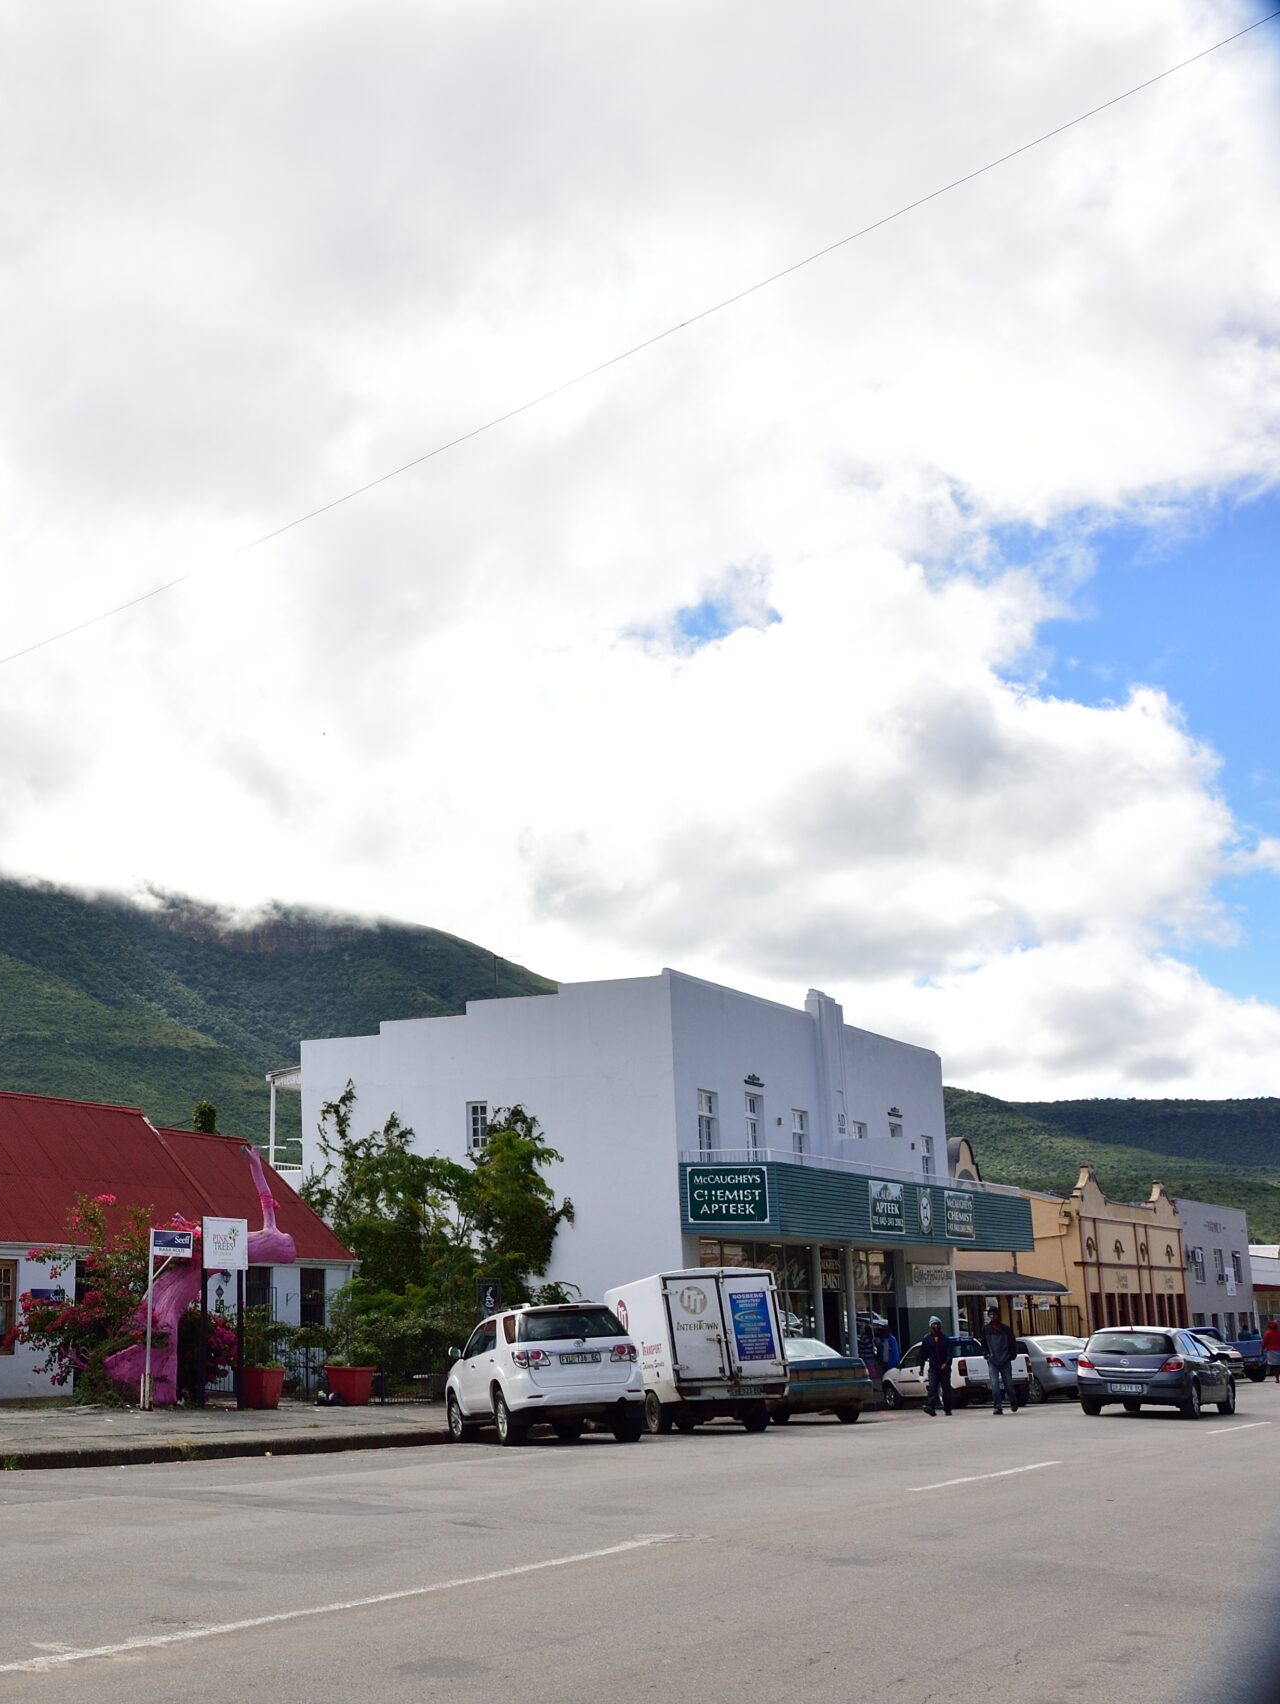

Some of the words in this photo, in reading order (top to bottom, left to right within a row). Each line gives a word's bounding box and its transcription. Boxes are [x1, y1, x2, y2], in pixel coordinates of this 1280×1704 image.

[694, 1189, 762, 1201] CHEMIST
[700, 1203, 755, 1215] APTEEK
[875, 1202, 900, 1215] APTEEK
[947, 1210, 973, 1223] CHEMIST
[212, 1234, 229, 1244] PINK
[214, 1242, 234, 1251] TREES
